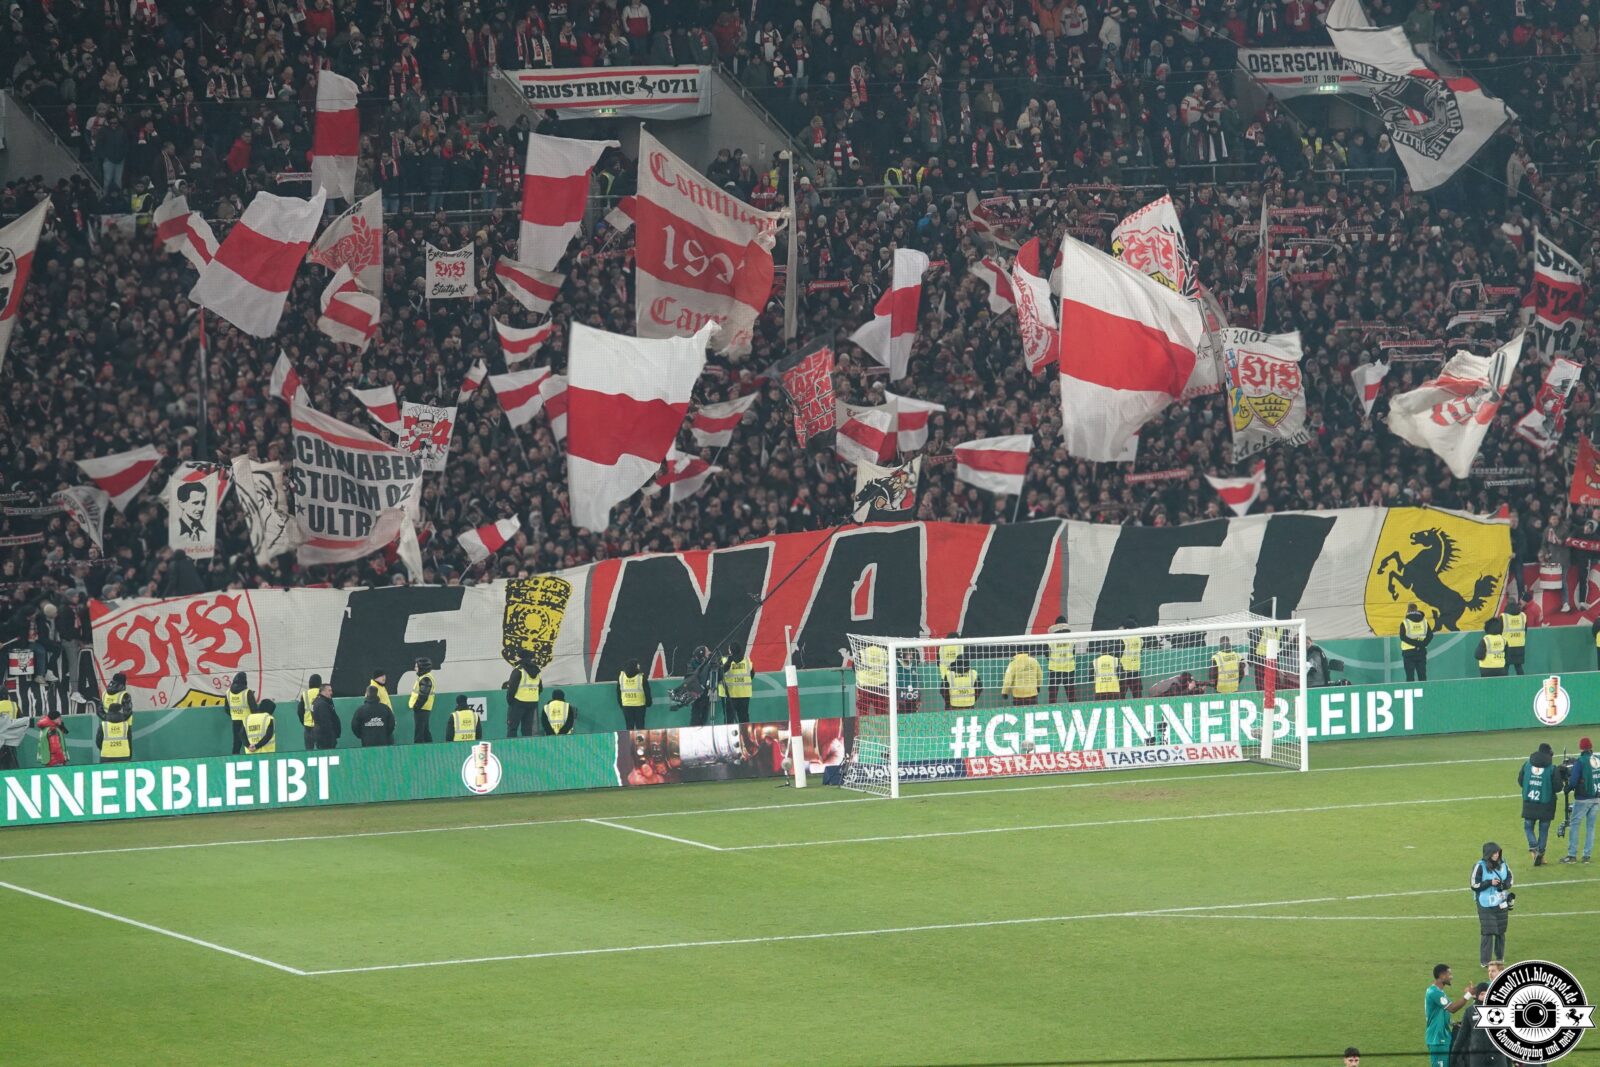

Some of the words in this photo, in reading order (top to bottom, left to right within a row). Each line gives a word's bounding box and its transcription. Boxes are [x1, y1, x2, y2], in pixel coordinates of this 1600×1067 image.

[522, 80, 635, 99] BRUSTRING
[657, 78, 698, 94] 0711
[1303, 75, 1318, 84] SEIT
[1426, 134, 1452, 160] SEIT
[293, 466, 381, 511] STURM
[308, 503, 385, 537] ULTR
[212, 675, 232, 690] 93
[150, 691, 168, 707] 18
[863, 763, 955, 779] Volswagen
[989, 751, 1082, 774] STRAUSS
[4, 756, 340, 820] NNERBLEIBT
[1527, 790, 1541, 801] 42
